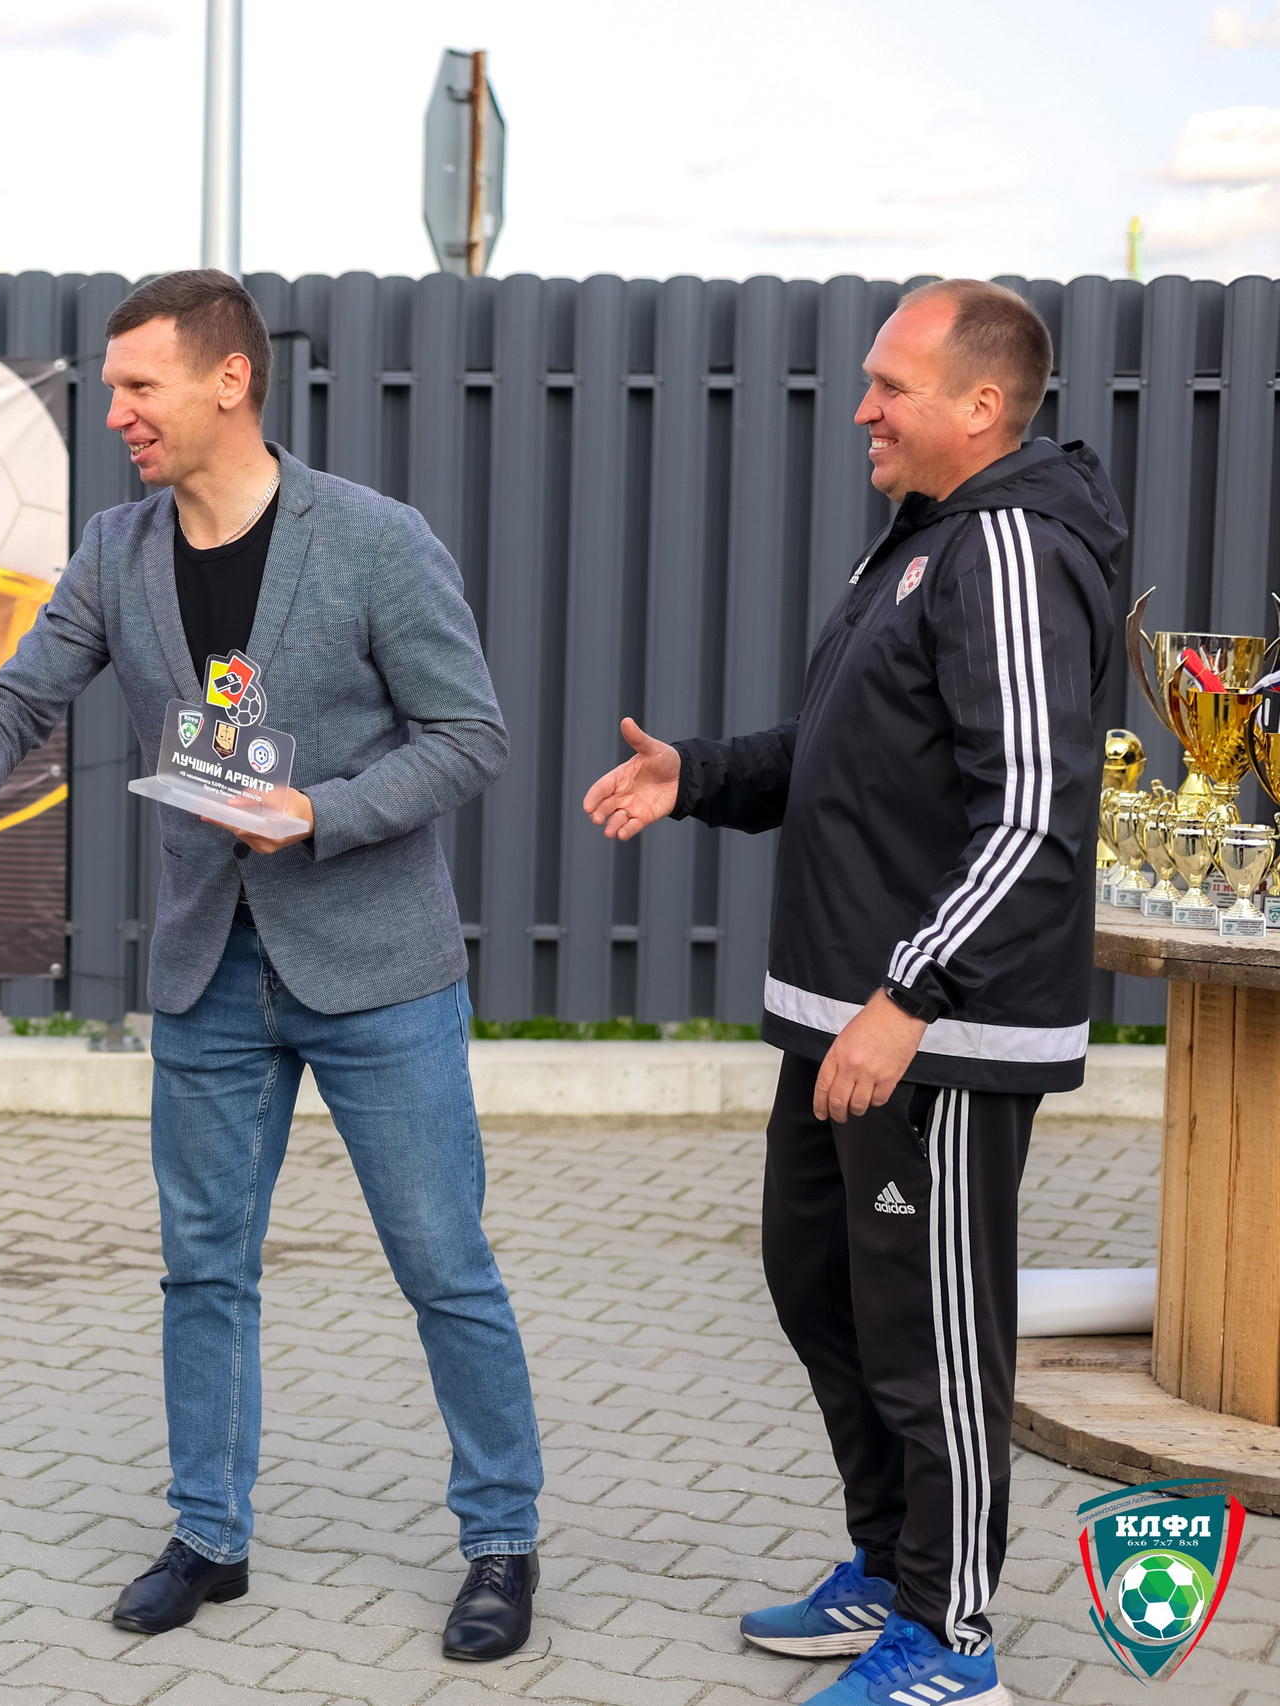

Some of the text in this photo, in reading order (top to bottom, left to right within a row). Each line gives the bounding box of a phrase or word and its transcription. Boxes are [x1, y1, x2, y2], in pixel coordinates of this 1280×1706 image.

[171, 751, 223, 778] ЛУЧШИЙ
[224, 769, 275, 794] АРБИТР
[874, 1201, 916, 1214] adidas
